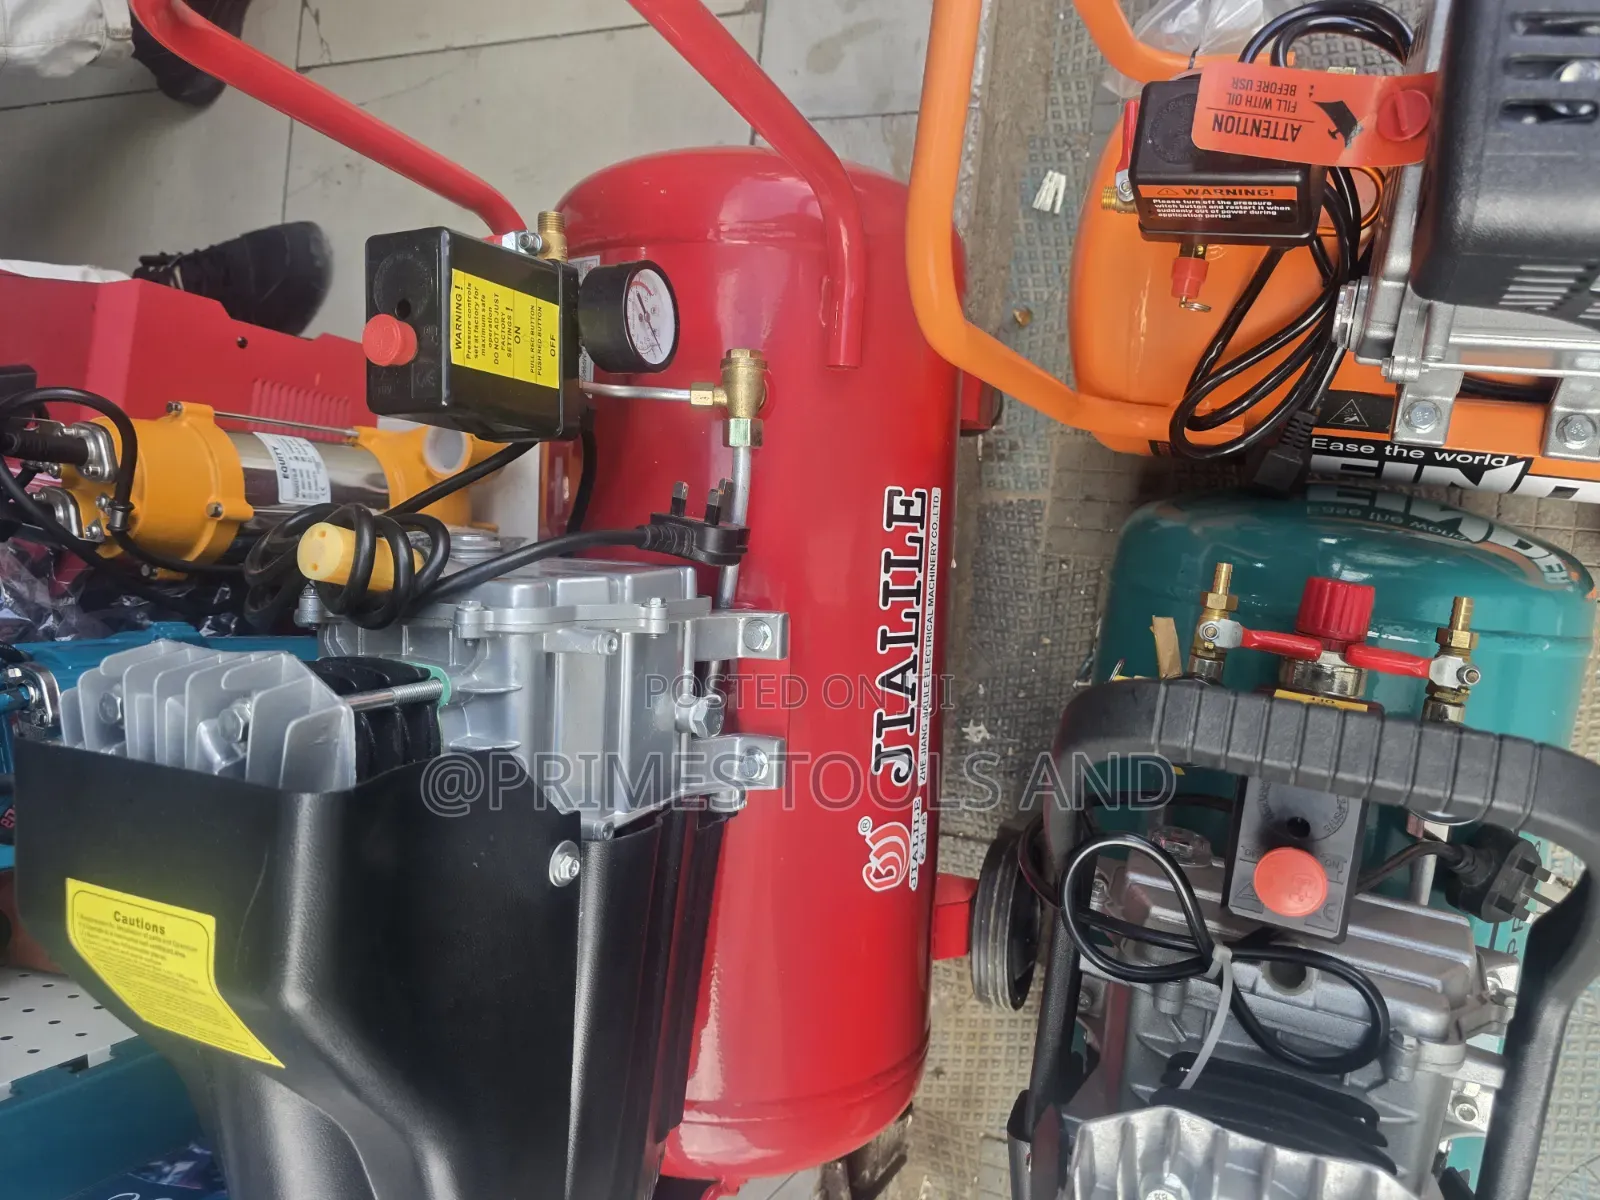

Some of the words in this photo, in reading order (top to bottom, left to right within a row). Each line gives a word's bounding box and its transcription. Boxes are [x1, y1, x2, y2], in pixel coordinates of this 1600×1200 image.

[1227, 92, 1242, 107] OIL
[1256, 80, 1297, 96] BEFORE
[1245, 95, 1272, 110] WITH
[1277, 98, 1298, 113] FILL
[1212, 113, 1302, 142] ATTENTION
[1182, 188, 1275, 196] WARNING!
[514, 326, 520, 344] ON
[494, 352, 499, 365] DO
[272, 446, 289, 479] EQUITY
[1311, 437, 1375, 454] Ease
[1384, 444, 1425, 459] the
[1434, 451, 1509, 468] world
[928, 541, 937, 607] MACHINERY
[873, 487, 927, 785] JIALILE
[925, 609, 935, 684] ELECTRICAL
[911, 799, 921, 889] JIALILE
[113, 910, 166, 935] Cautions
